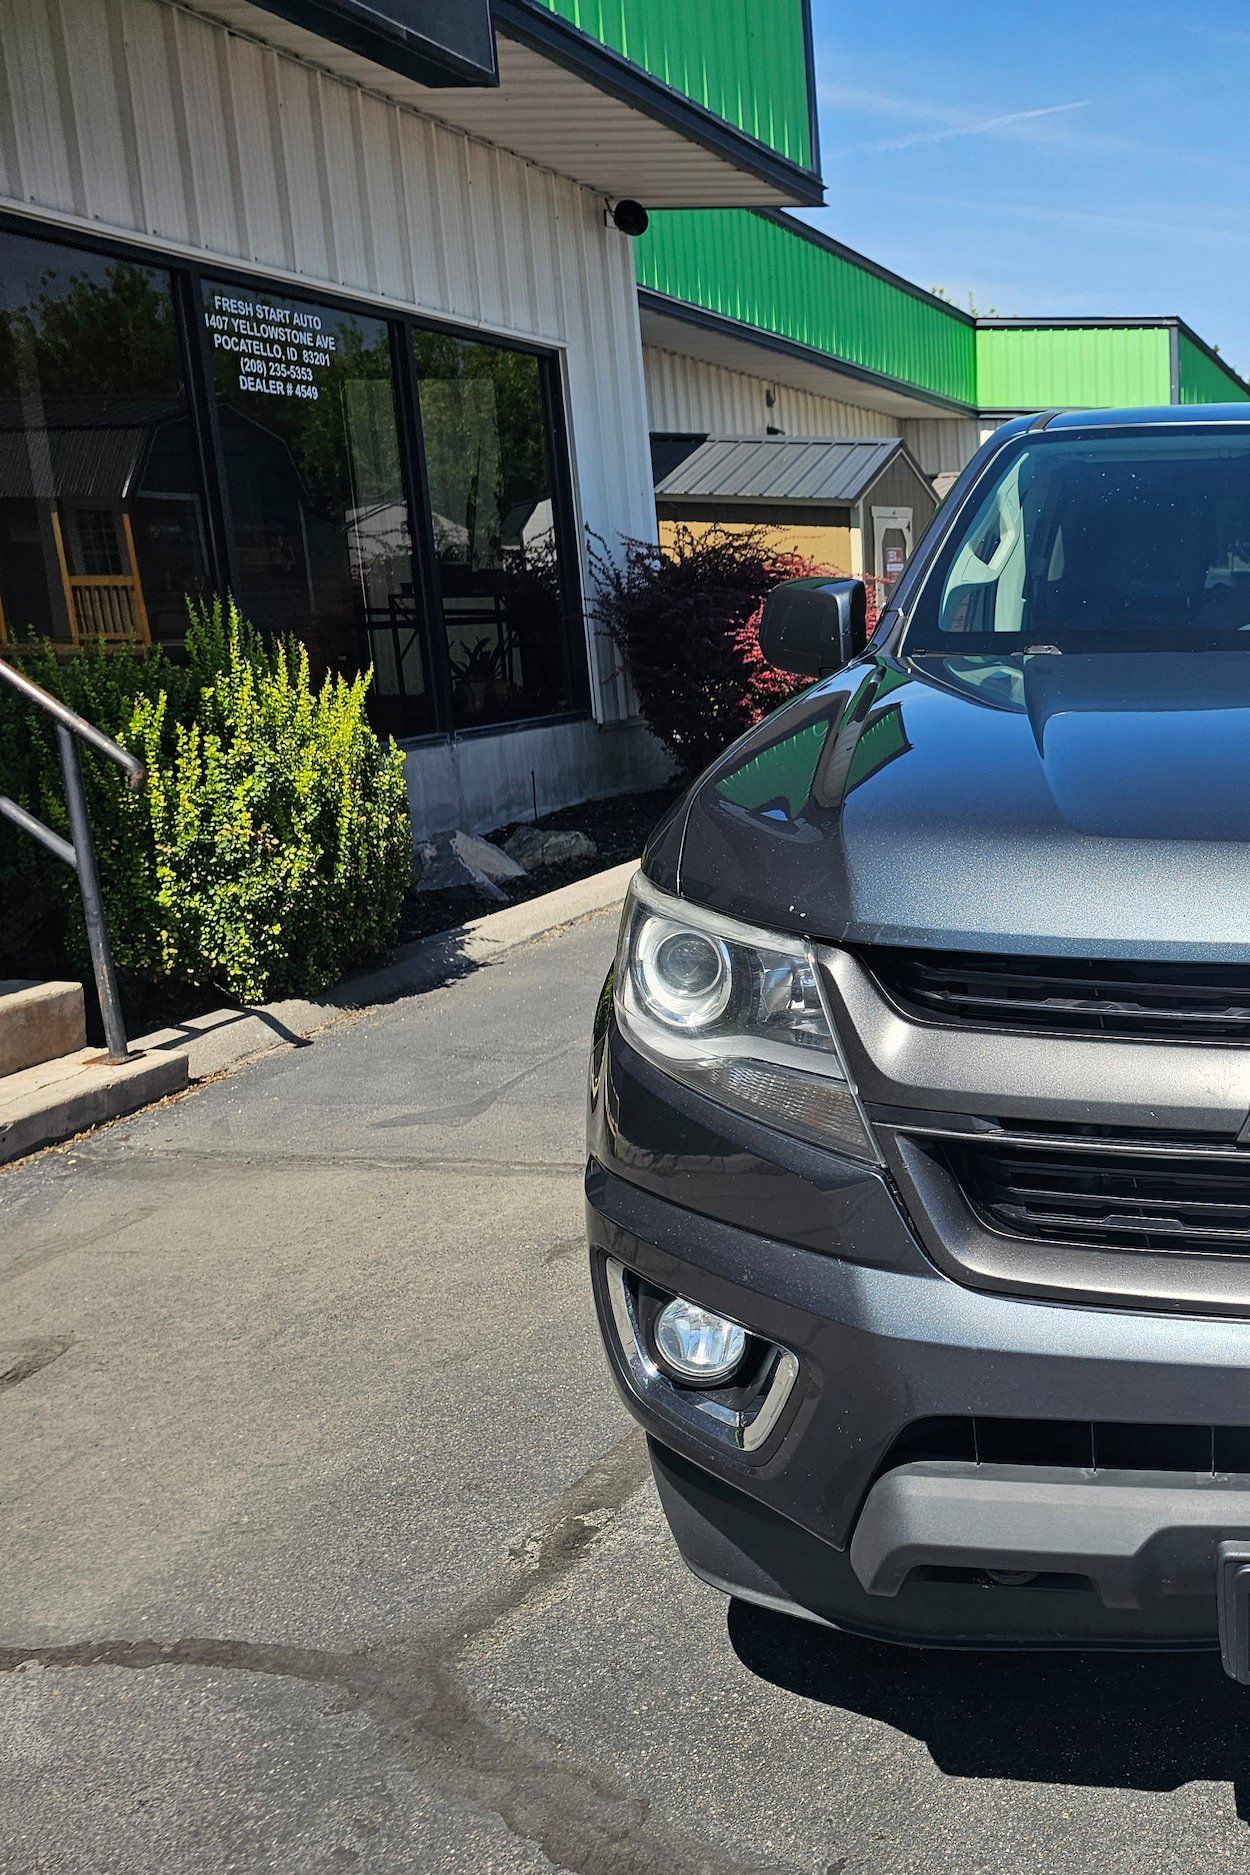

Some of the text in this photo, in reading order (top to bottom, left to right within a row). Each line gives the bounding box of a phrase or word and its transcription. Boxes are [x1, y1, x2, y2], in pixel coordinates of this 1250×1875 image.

[214, 295, 322, 331] FRESH START AUTO
[204, 313, 336, 351] 1407 YELLOWSTONE AVE
[213, 333, 331, 367] POCATELLO, ID 83201
[240, 356, 313, 382] (208) 235-5353
[239, 375, 319, 400] DEALER # 4549
